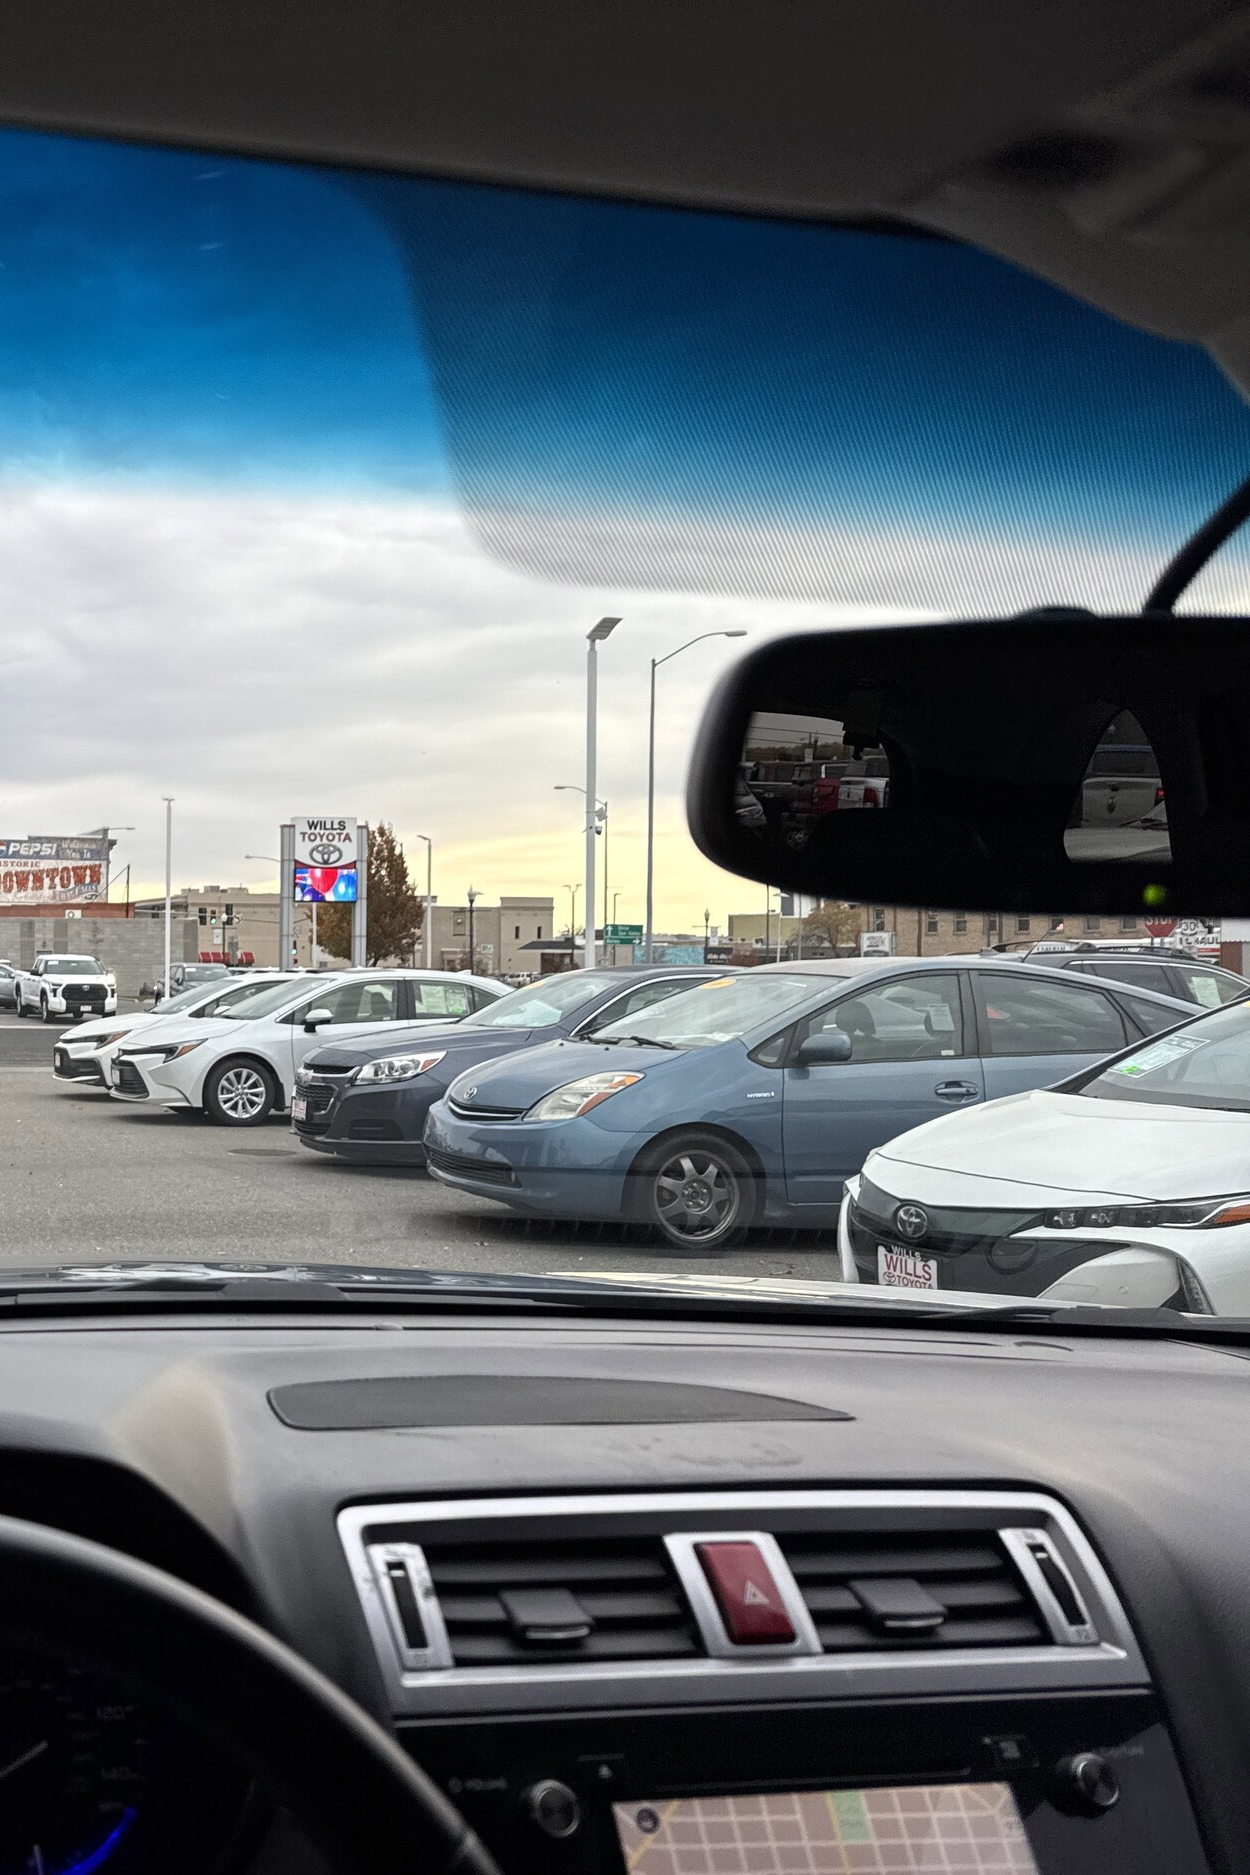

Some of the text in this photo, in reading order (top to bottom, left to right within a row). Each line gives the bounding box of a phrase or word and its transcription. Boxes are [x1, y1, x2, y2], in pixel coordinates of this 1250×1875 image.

[307, 820, 346, 831] WILLS
[300, 832, 352, 843] TOYOTA
[8, 842, 57, 856] PEPSI
[1182, 921, 1196, 931] 30
[891, 1245, 921, 1261] WILLS
[884, 1253, 932, 1281] WILLS
[896, 1274, 934, 1290] TOYOTA
